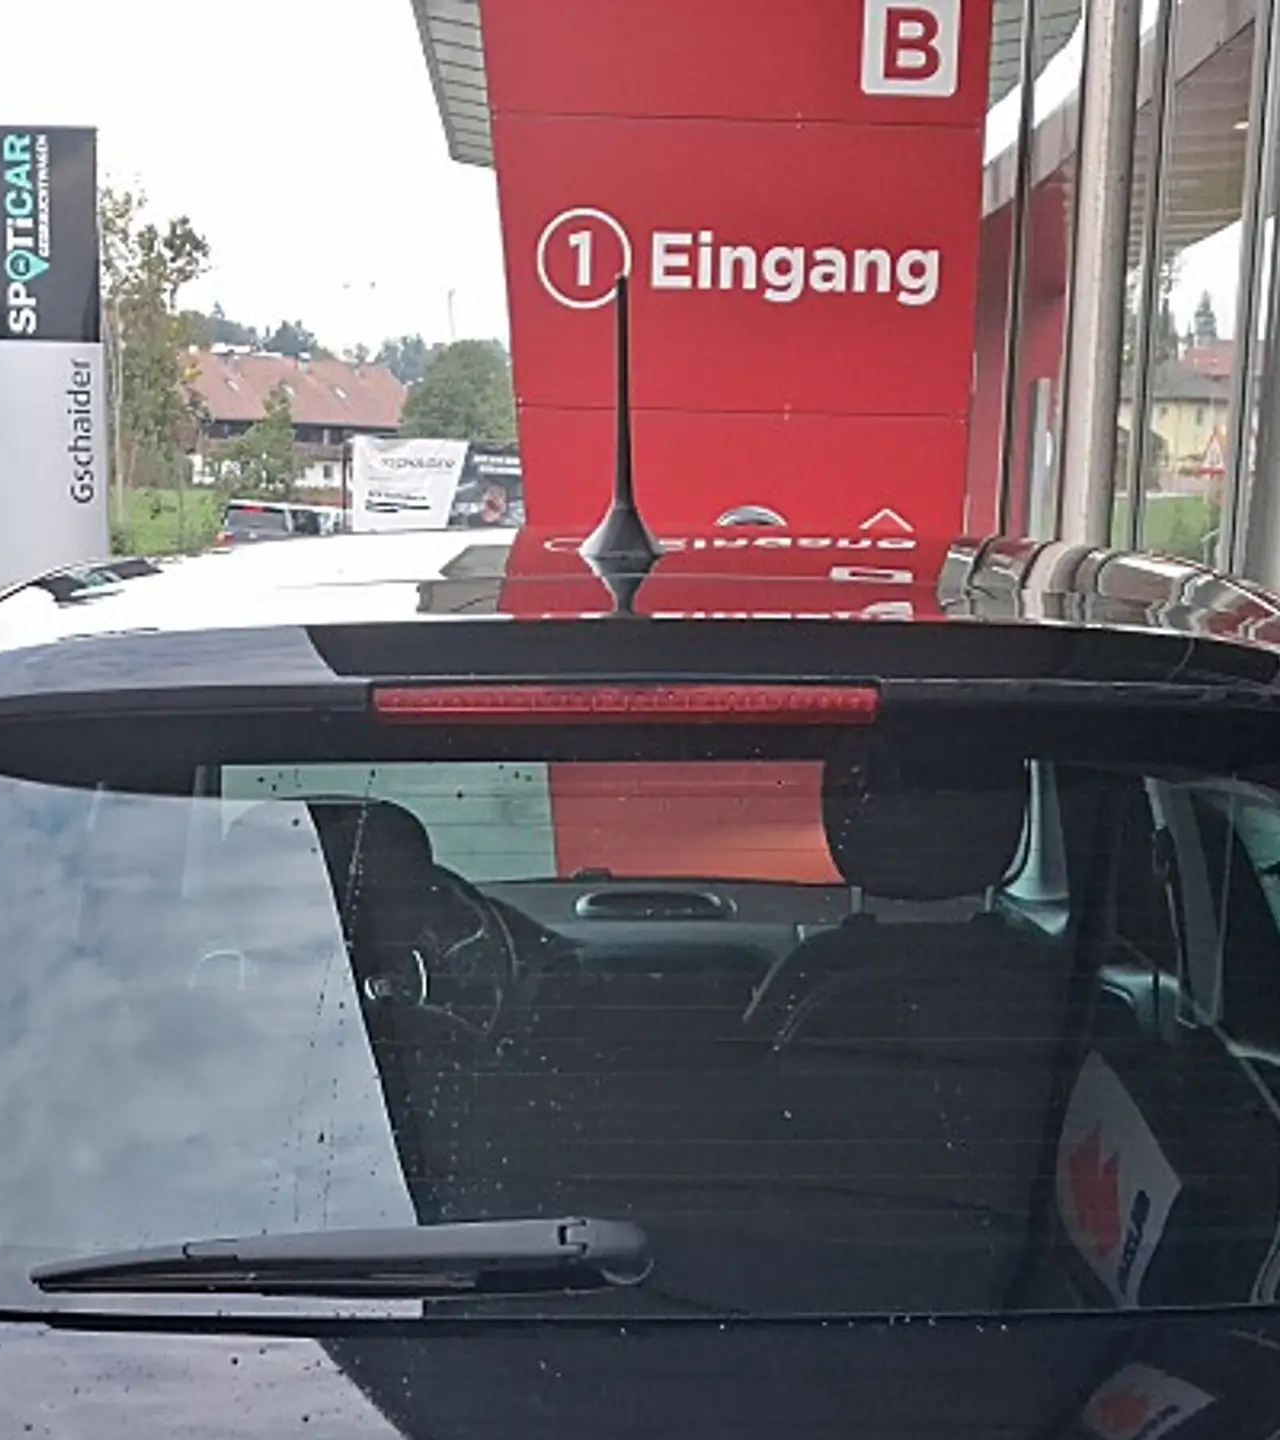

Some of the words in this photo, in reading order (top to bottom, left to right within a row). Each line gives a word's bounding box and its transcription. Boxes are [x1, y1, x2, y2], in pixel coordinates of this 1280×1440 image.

[884, 7, 941, 80] B
[568, 230, 594, 287] 1
[651, 230, 941, 306] Eingang
[66, 358, 95, 504] Gschaider
